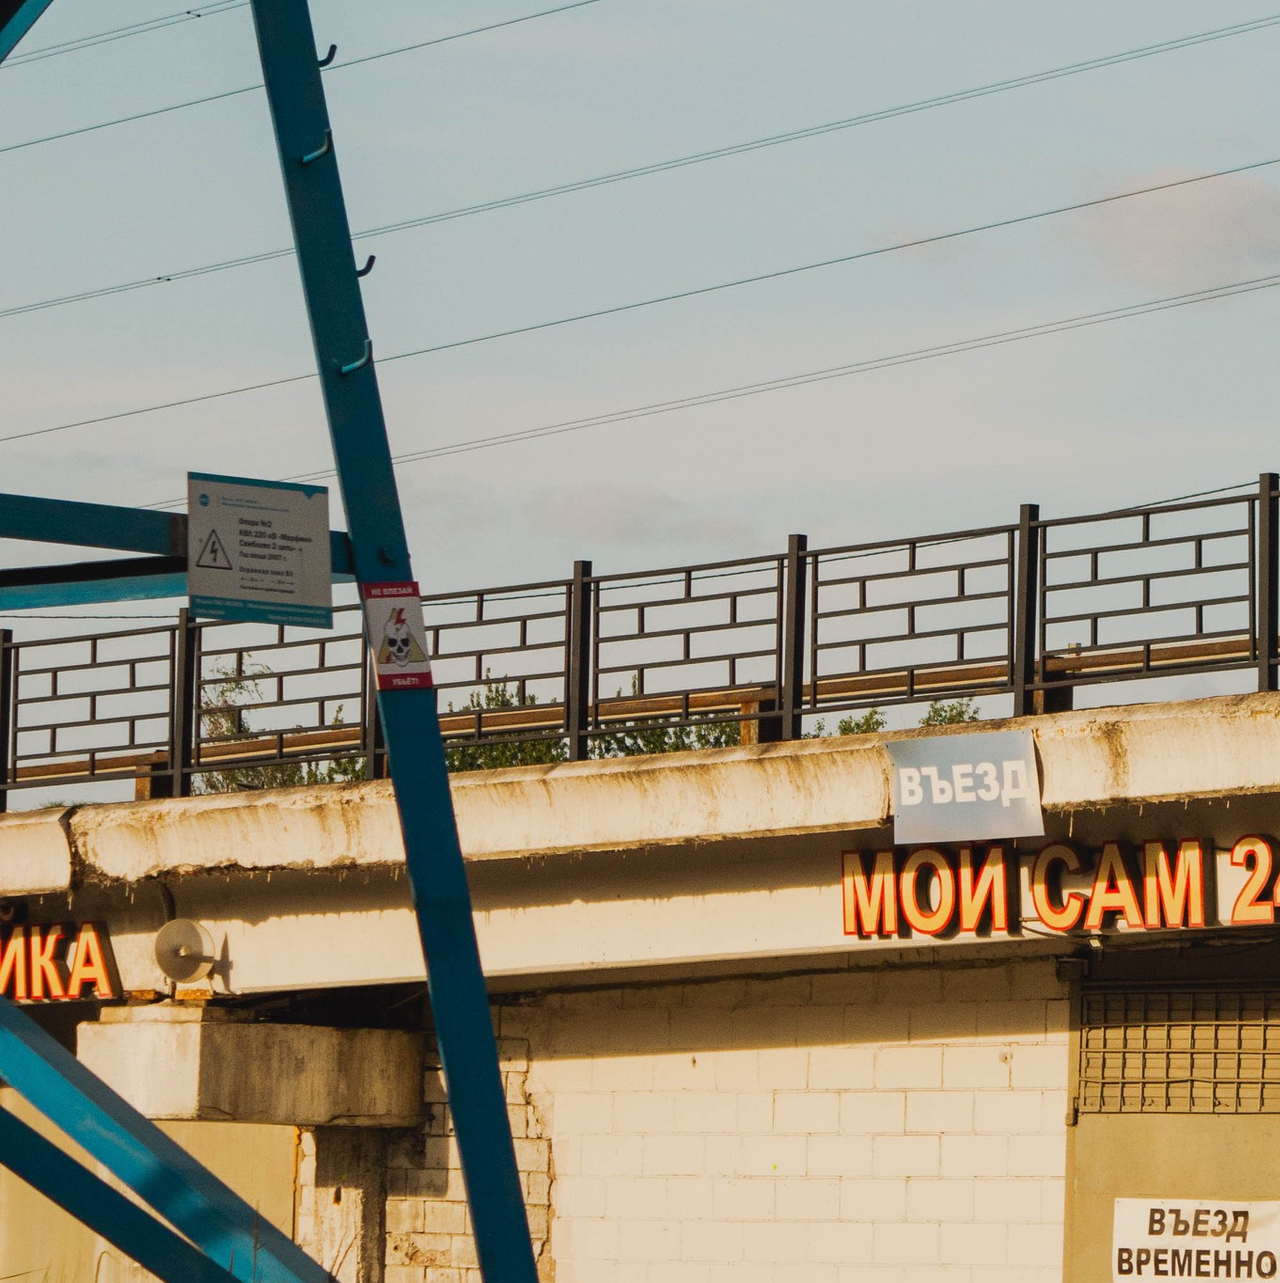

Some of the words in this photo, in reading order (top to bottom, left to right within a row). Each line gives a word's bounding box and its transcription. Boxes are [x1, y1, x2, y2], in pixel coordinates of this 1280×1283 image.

[898, 759, 1033, 808] ВЪЕЗД
[1031, 836, 1205, 932] САМ
[1147, 1207, 1250, 1244] ВЪЕЗД
[1117, 1247, 1278, 1280] ВРЕМЕННО
